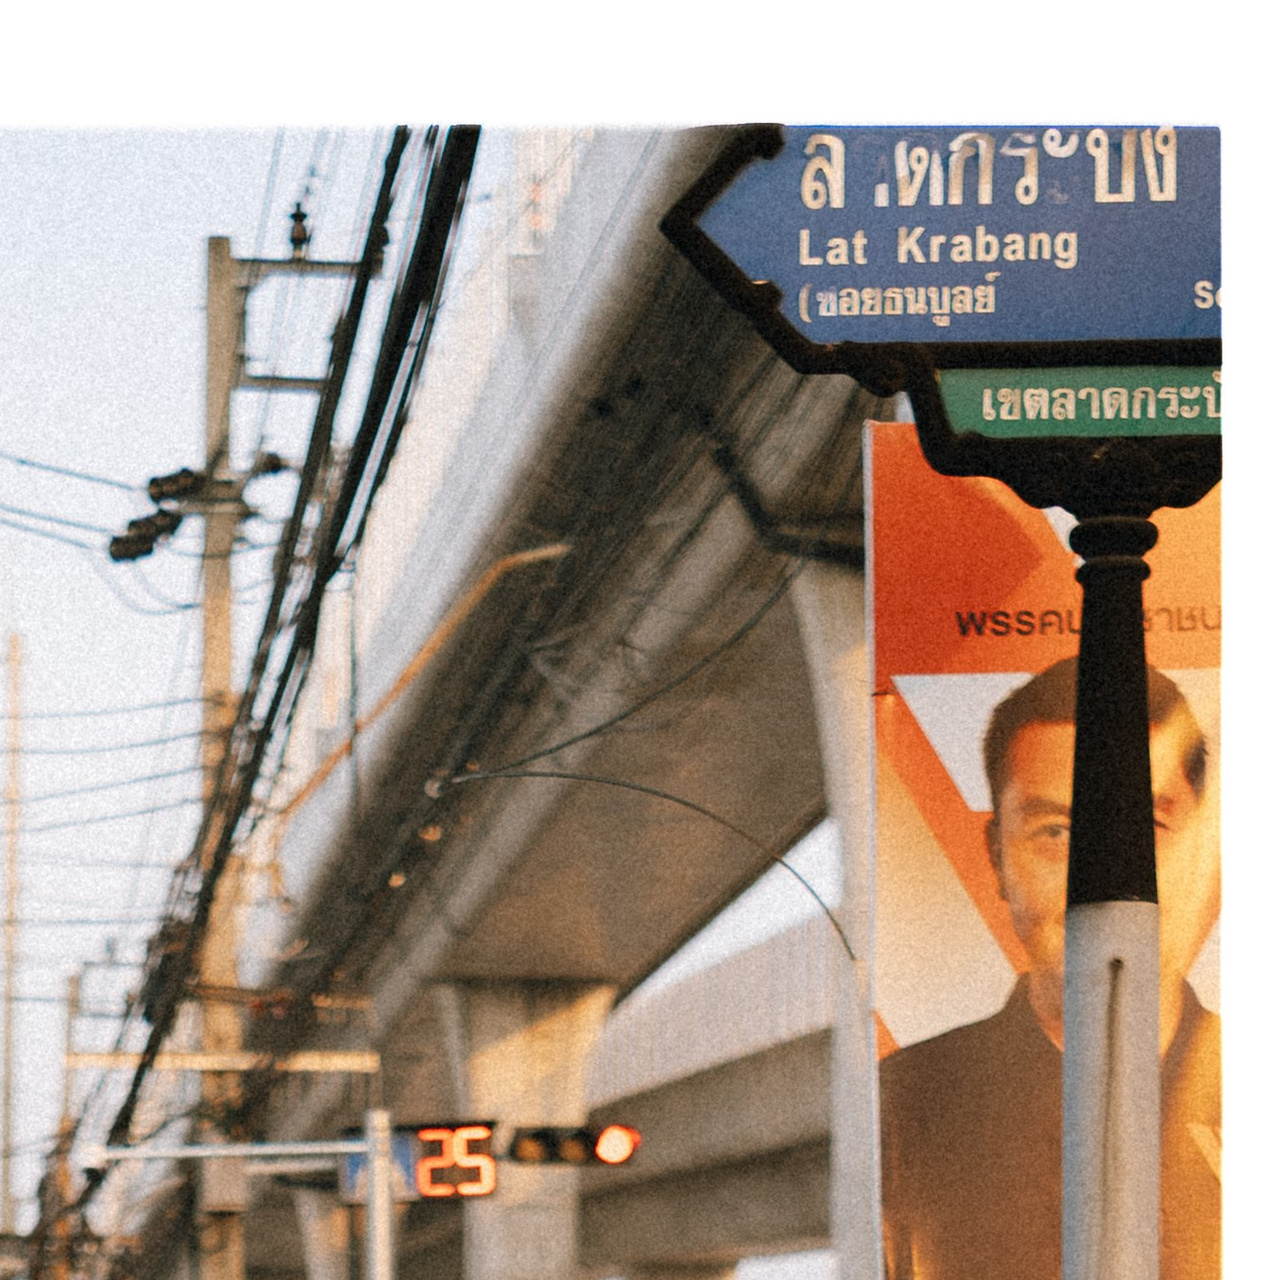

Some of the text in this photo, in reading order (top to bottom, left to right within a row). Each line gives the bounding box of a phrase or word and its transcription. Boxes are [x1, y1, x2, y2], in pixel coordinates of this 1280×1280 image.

[799, 225, 1079, 269] Lat Krabang
[1194, 280, 1222, 309] S
[416, 1125, 496, 1196] 25
